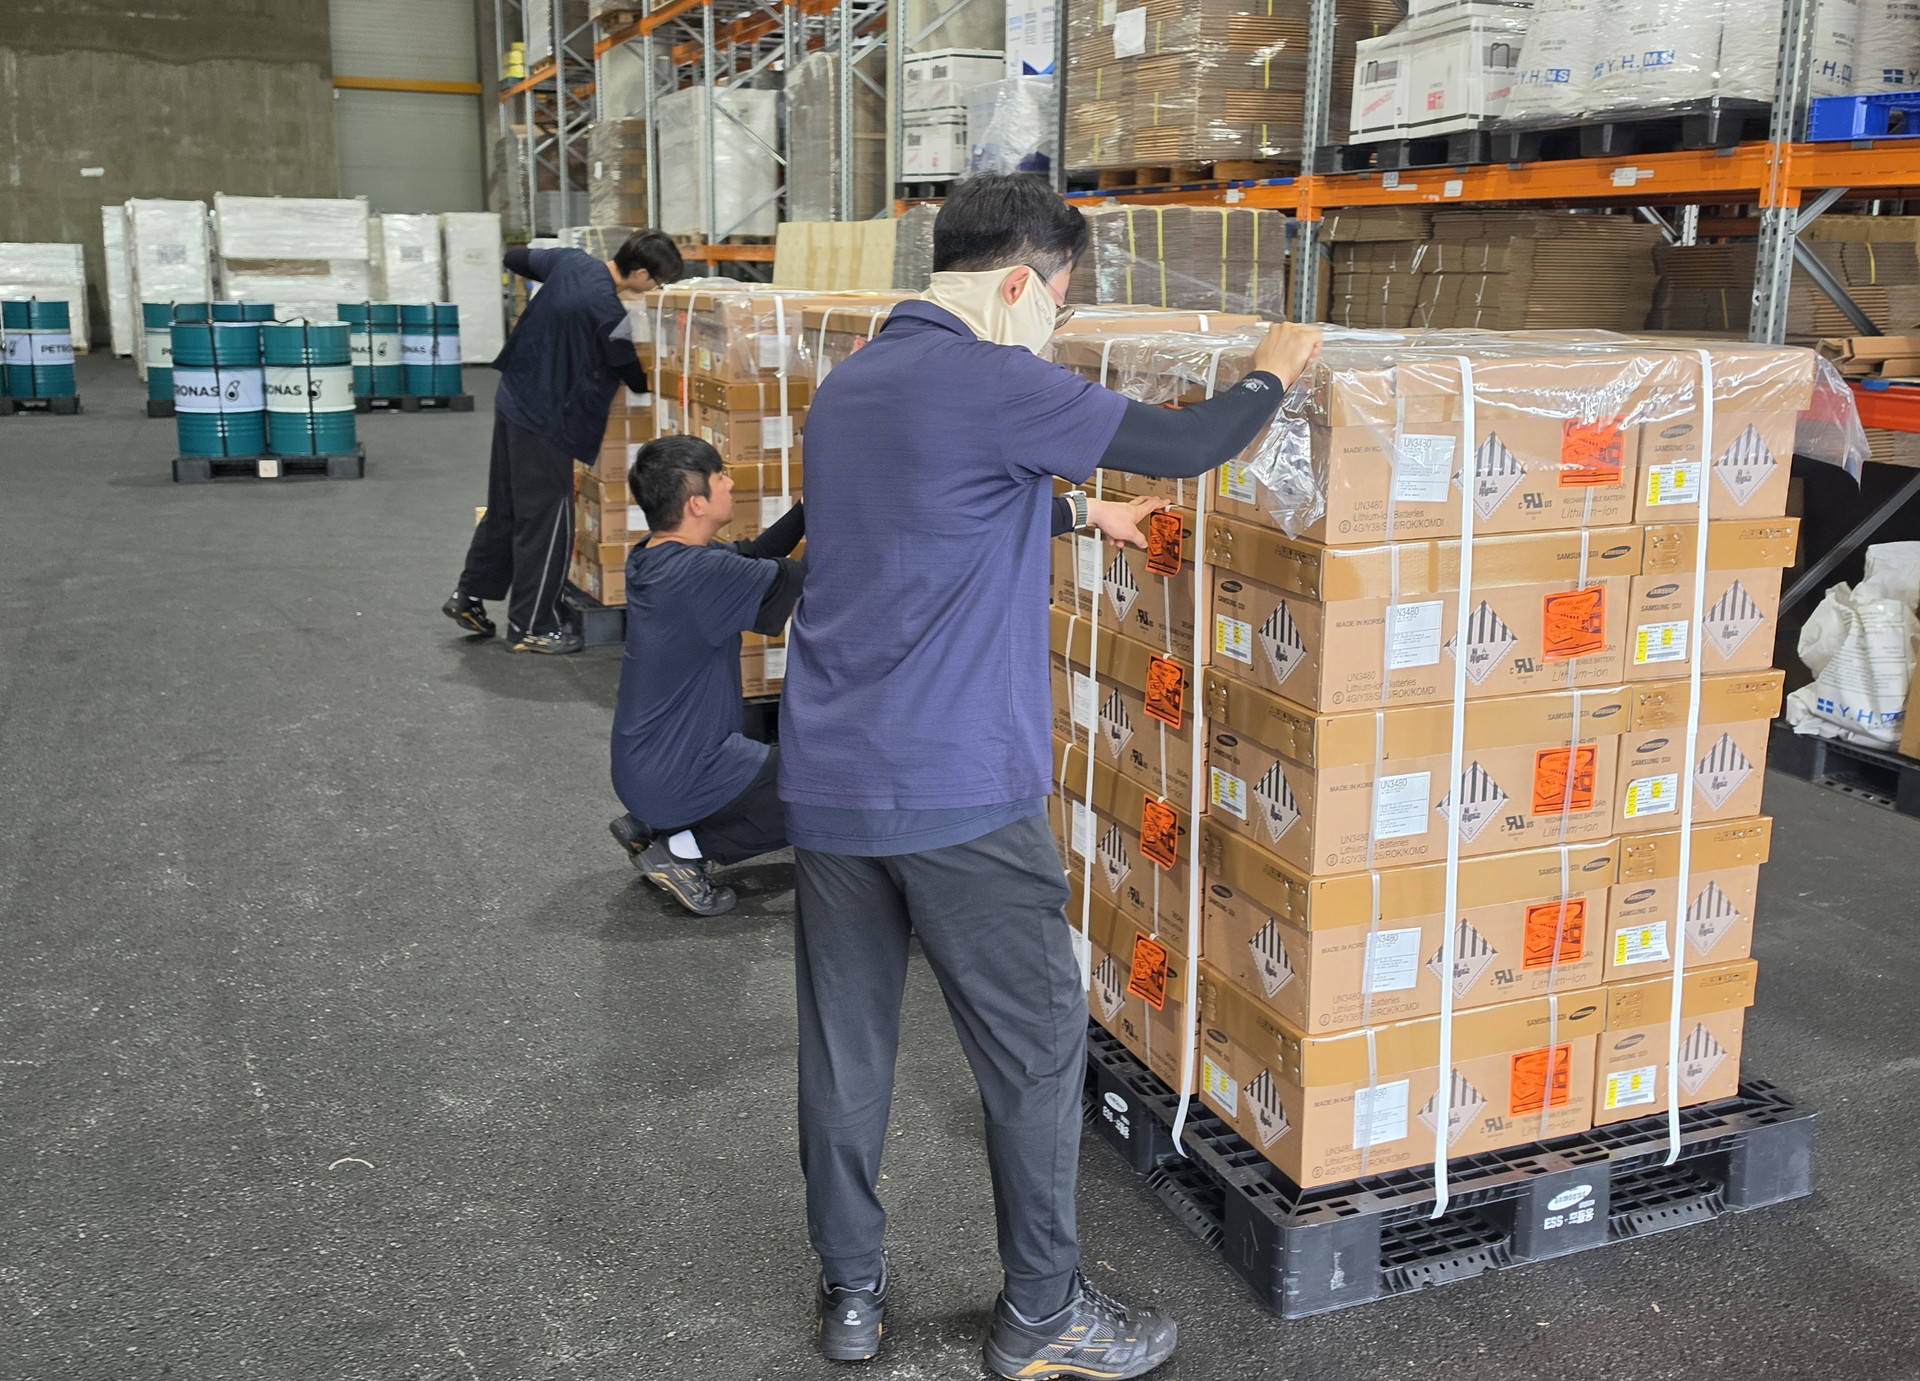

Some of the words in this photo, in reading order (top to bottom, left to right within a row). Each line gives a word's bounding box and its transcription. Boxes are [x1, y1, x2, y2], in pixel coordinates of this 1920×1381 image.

[1354, 500, 1383, 511] UN3480
[1484, 501, 1490, 510] 9
[1353, 512, 1387, 522] Lithium-io
[1556, 552, 1582, 561] SAMSUN
[1397, 606, 1420, 617] N3480
[1641, 603, 1670, 612] SAMSUNG
[1347, 671, 1376, 682] UN3480
[1547, 711, 1574, 721] SAMSUN
[1330, 784, 1349, 792] MADE
[1357, 781, 1374, 789] KORE
[1468, 827, 1473, 835] 9
[1348, 941, 1367, 950] KORE
